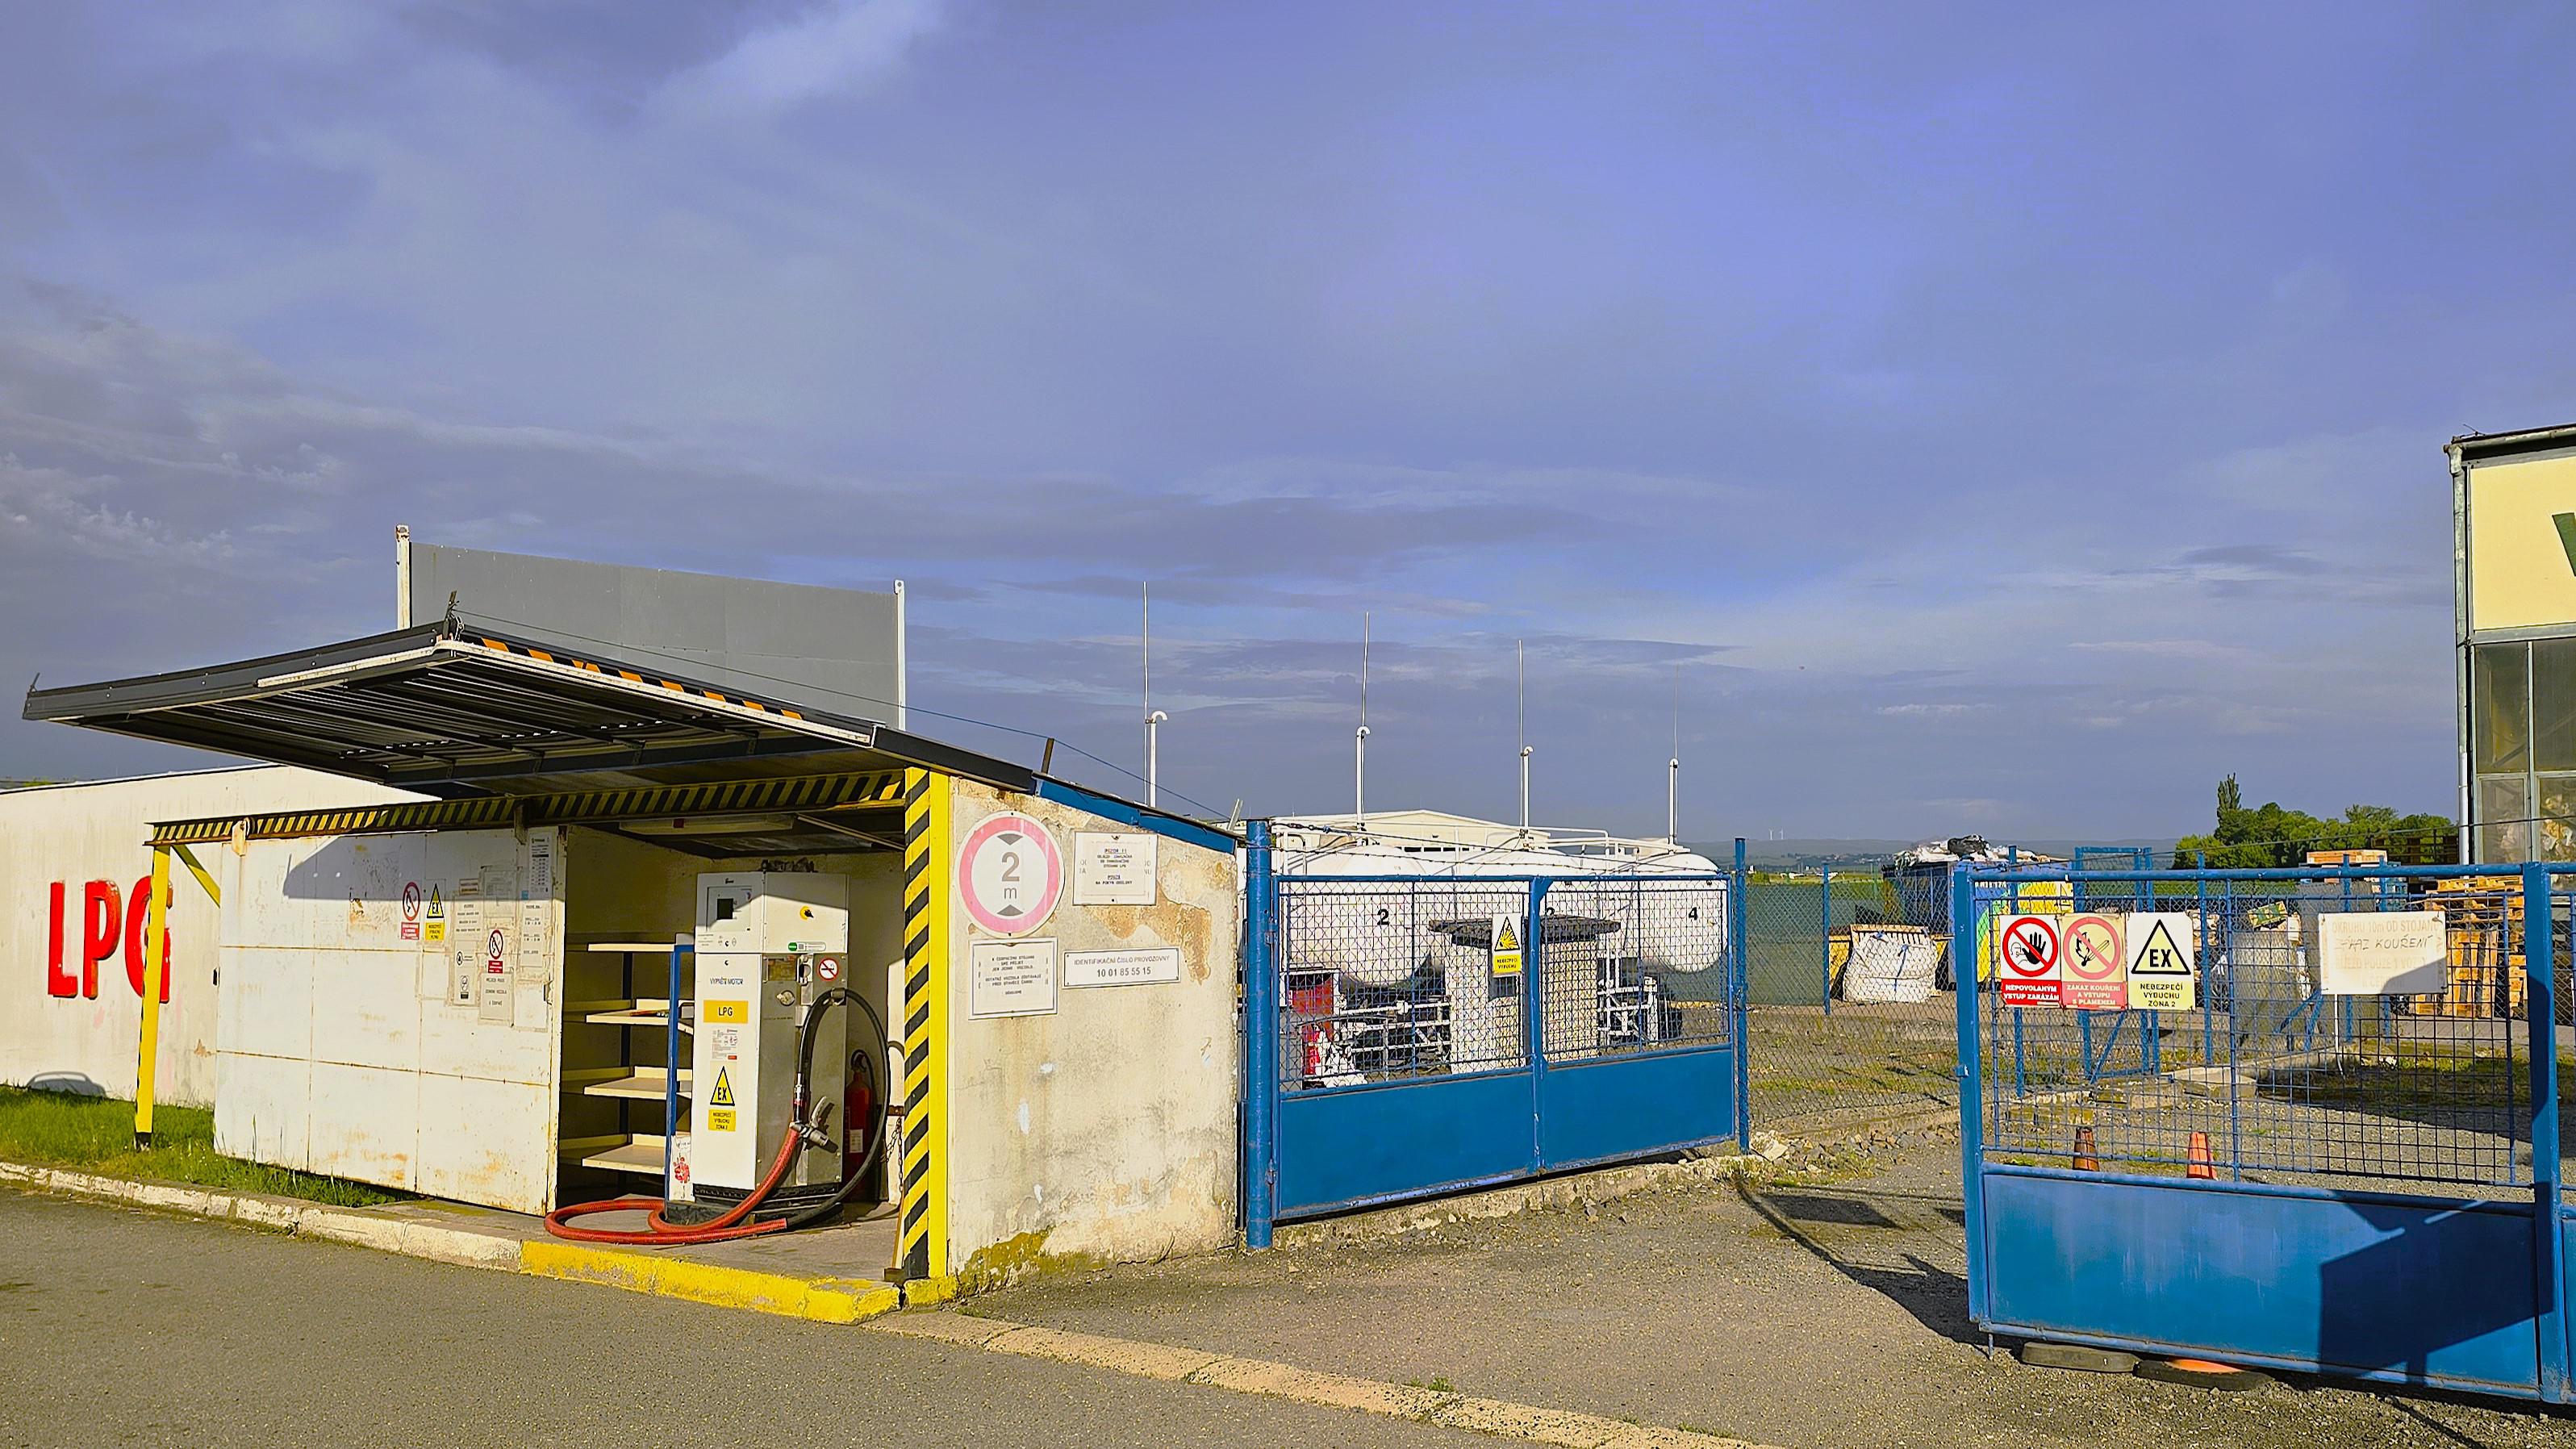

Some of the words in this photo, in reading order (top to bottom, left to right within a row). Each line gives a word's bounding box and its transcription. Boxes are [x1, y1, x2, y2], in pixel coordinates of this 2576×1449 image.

[1001, 851, 1020, 882] 2
[1004, 887, 1017, 900] m
[1376, 908, 1389, 925] 2
[1688, 907, 1697, 921] 4
[48, 875, 173, 1004] LPG
[1074, 957, 1116, 966] IDENTIFIKAČNÍ
[1134, 954, 1170, 963] PROVOZOVNY
[2149, 949, 2172, 967] EX
[1097, 969, 1106, 977] 10
[1108, 968, 1117, 977] 01
[1120, 968, 1129, 976] 85
[1131, 967, 1140, 975] 55
[1142, 967, 1151, 975] 15
[2005, 983, 2057, 992] NEPOVOLANÝM
[2140, 982, 2183, 991] NEBEZPEČÍ
[2143, 991, 2180, 1000] VÝBUCHU
[718, 1006, 733, 1017] LPG
[717, 1087, 727, 1100] EX
